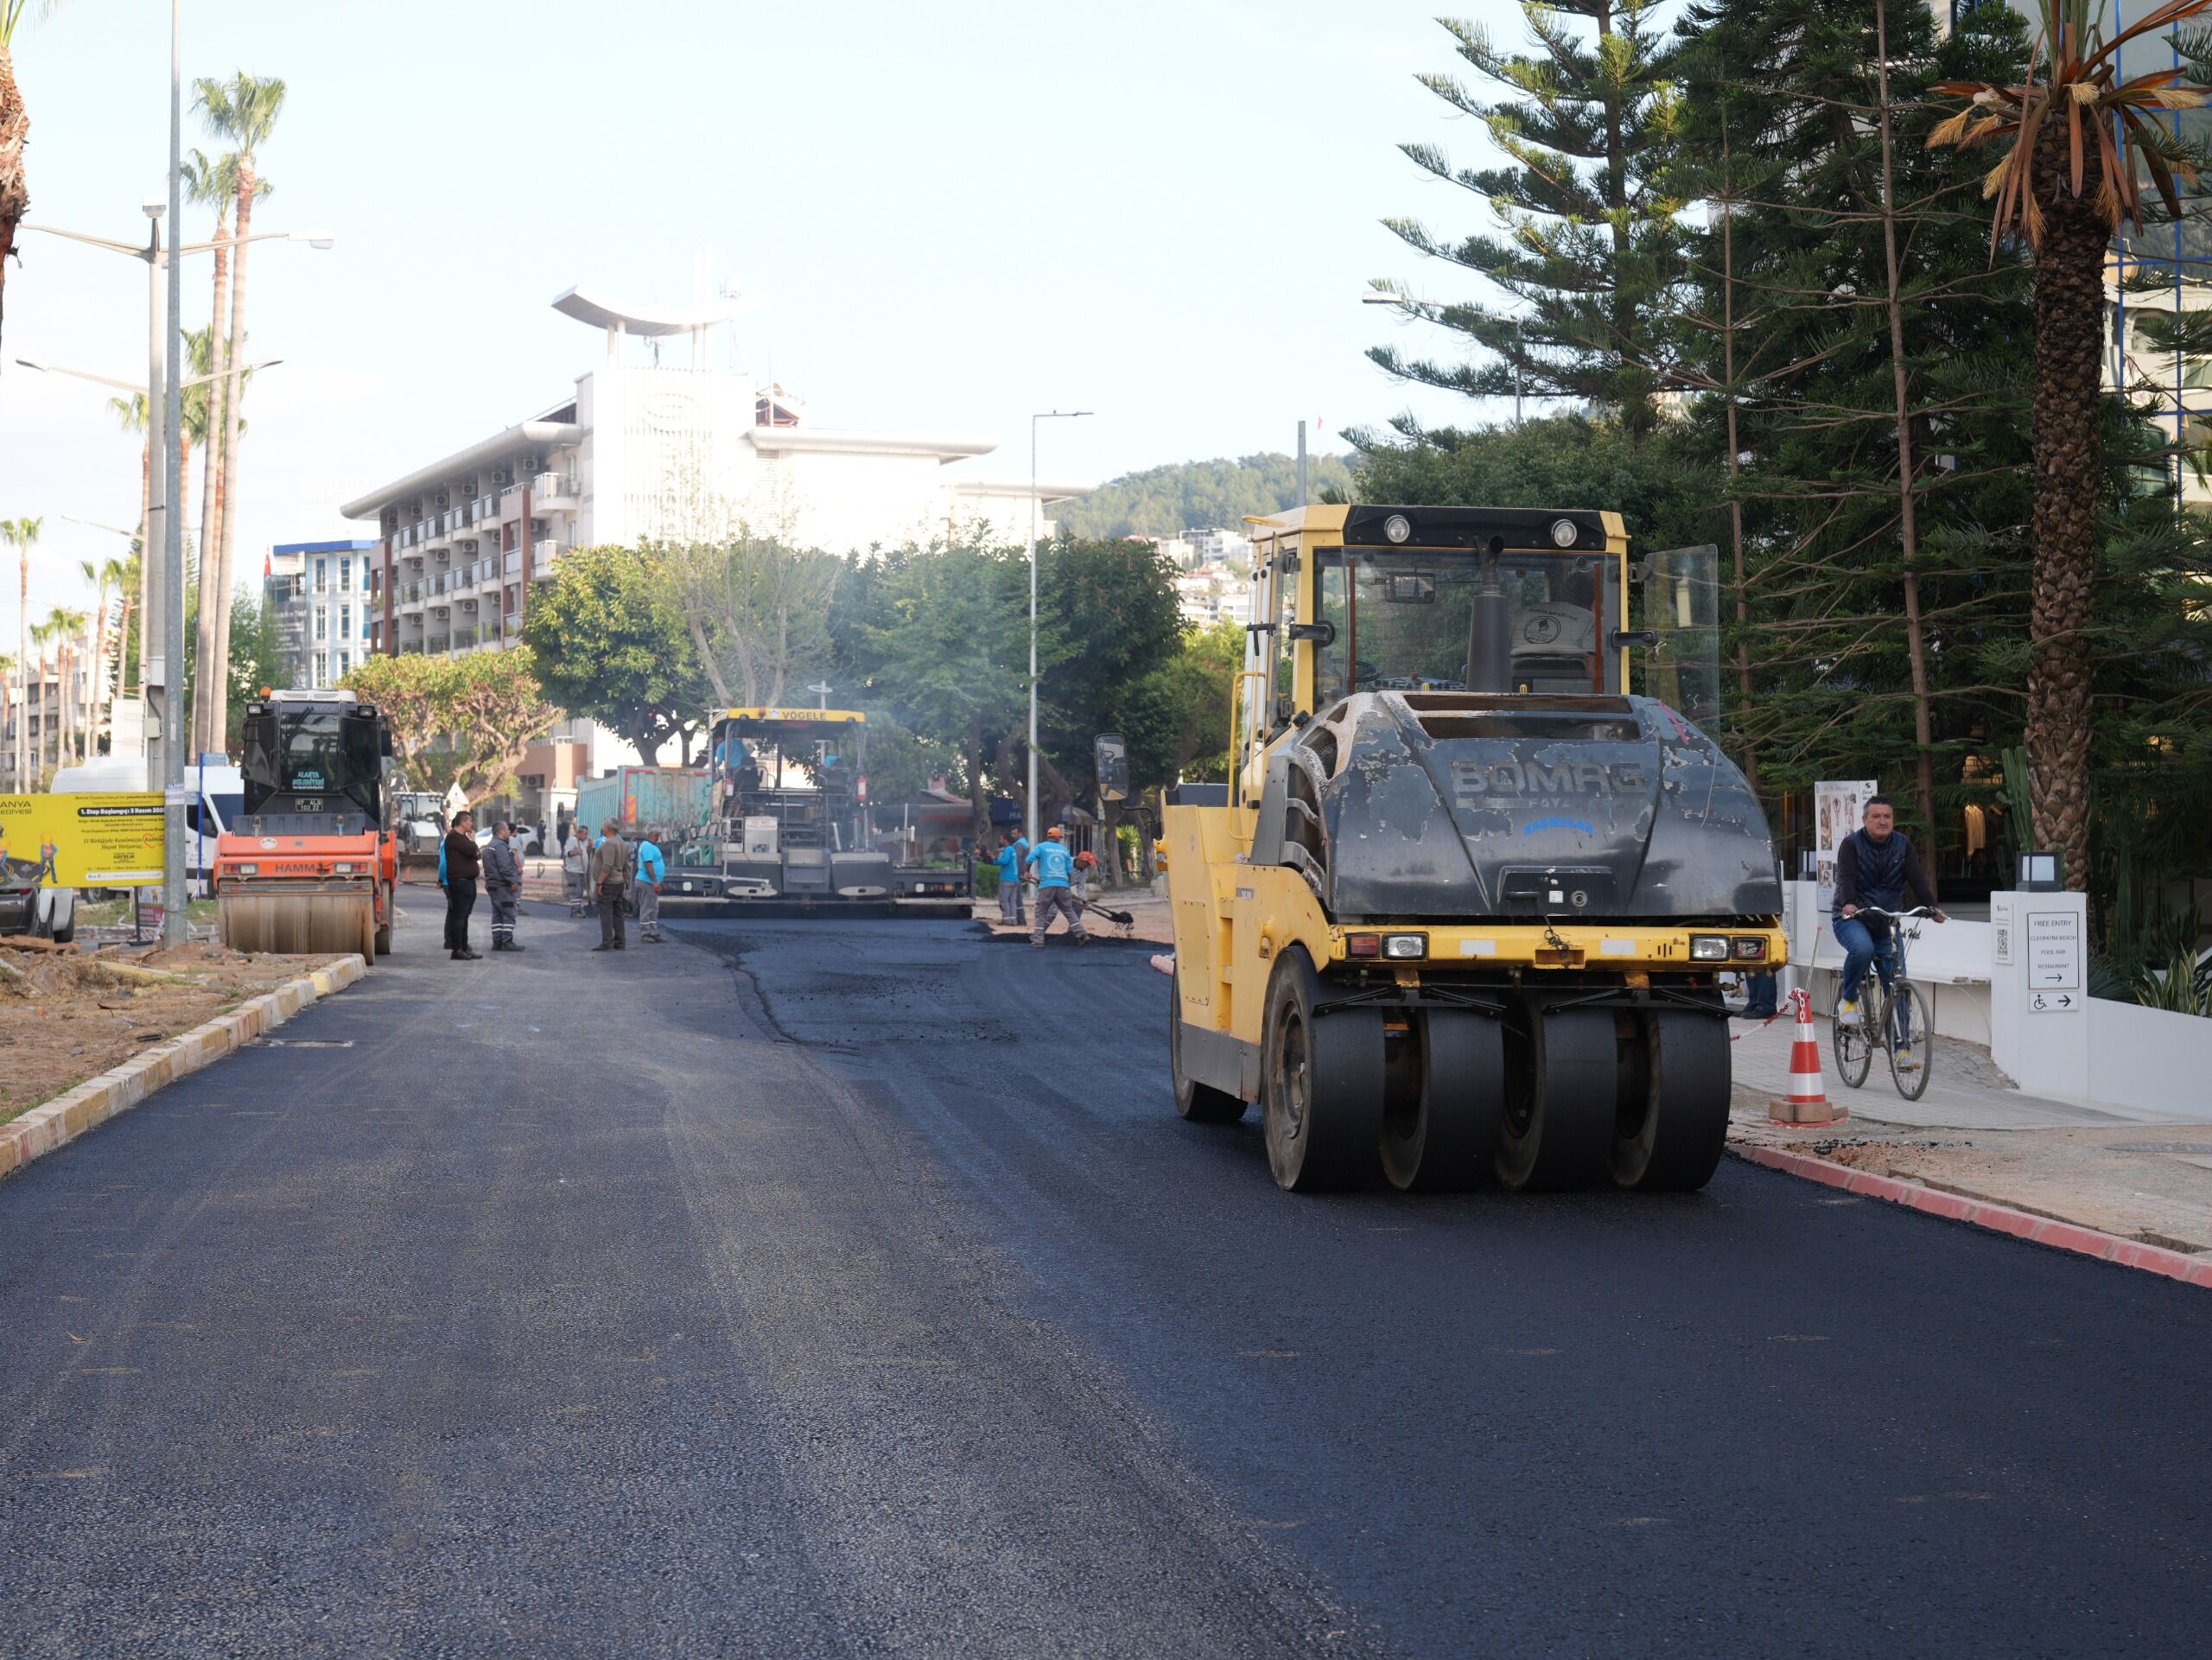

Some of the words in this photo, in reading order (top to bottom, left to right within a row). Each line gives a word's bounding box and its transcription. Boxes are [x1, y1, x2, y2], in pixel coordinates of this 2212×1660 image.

[782, 711, 827, 721] VÖGELE
[1452, 760, 1647, 793] BOMAG
[276, 863, 315, 873] HAMM
